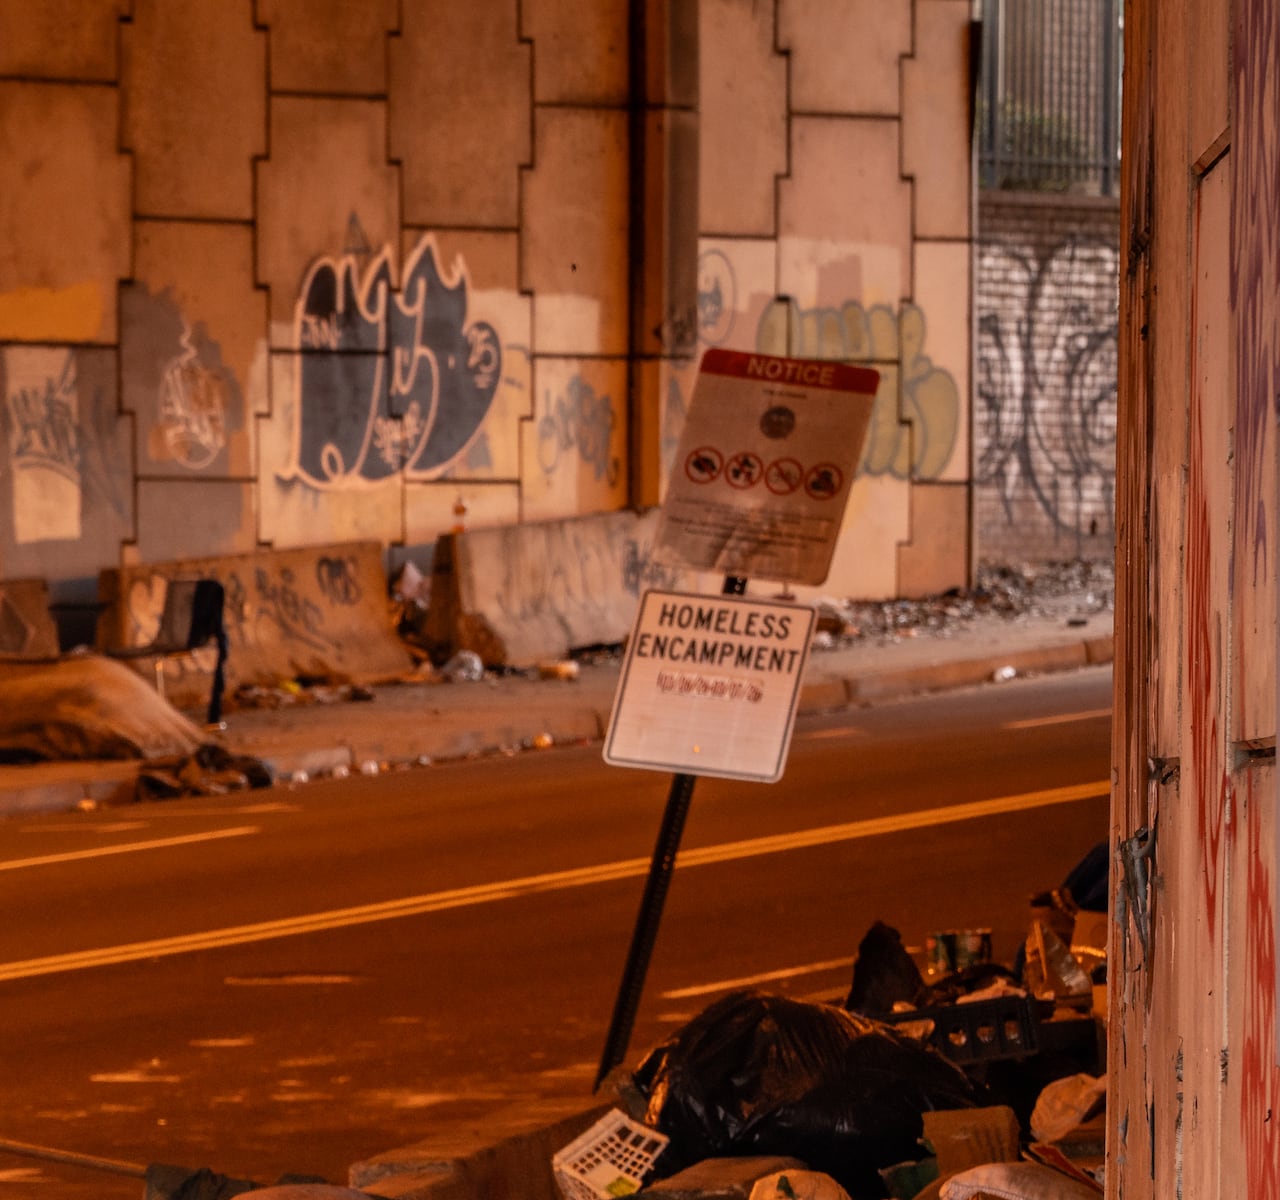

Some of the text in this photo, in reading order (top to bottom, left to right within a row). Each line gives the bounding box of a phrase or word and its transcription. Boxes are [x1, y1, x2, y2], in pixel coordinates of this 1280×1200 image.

[747, 358, 835, 386] NOTICE
[659, 603, 792, 640] HOMELESS
[637, 633, 800, 675] ENCAMPMENT
